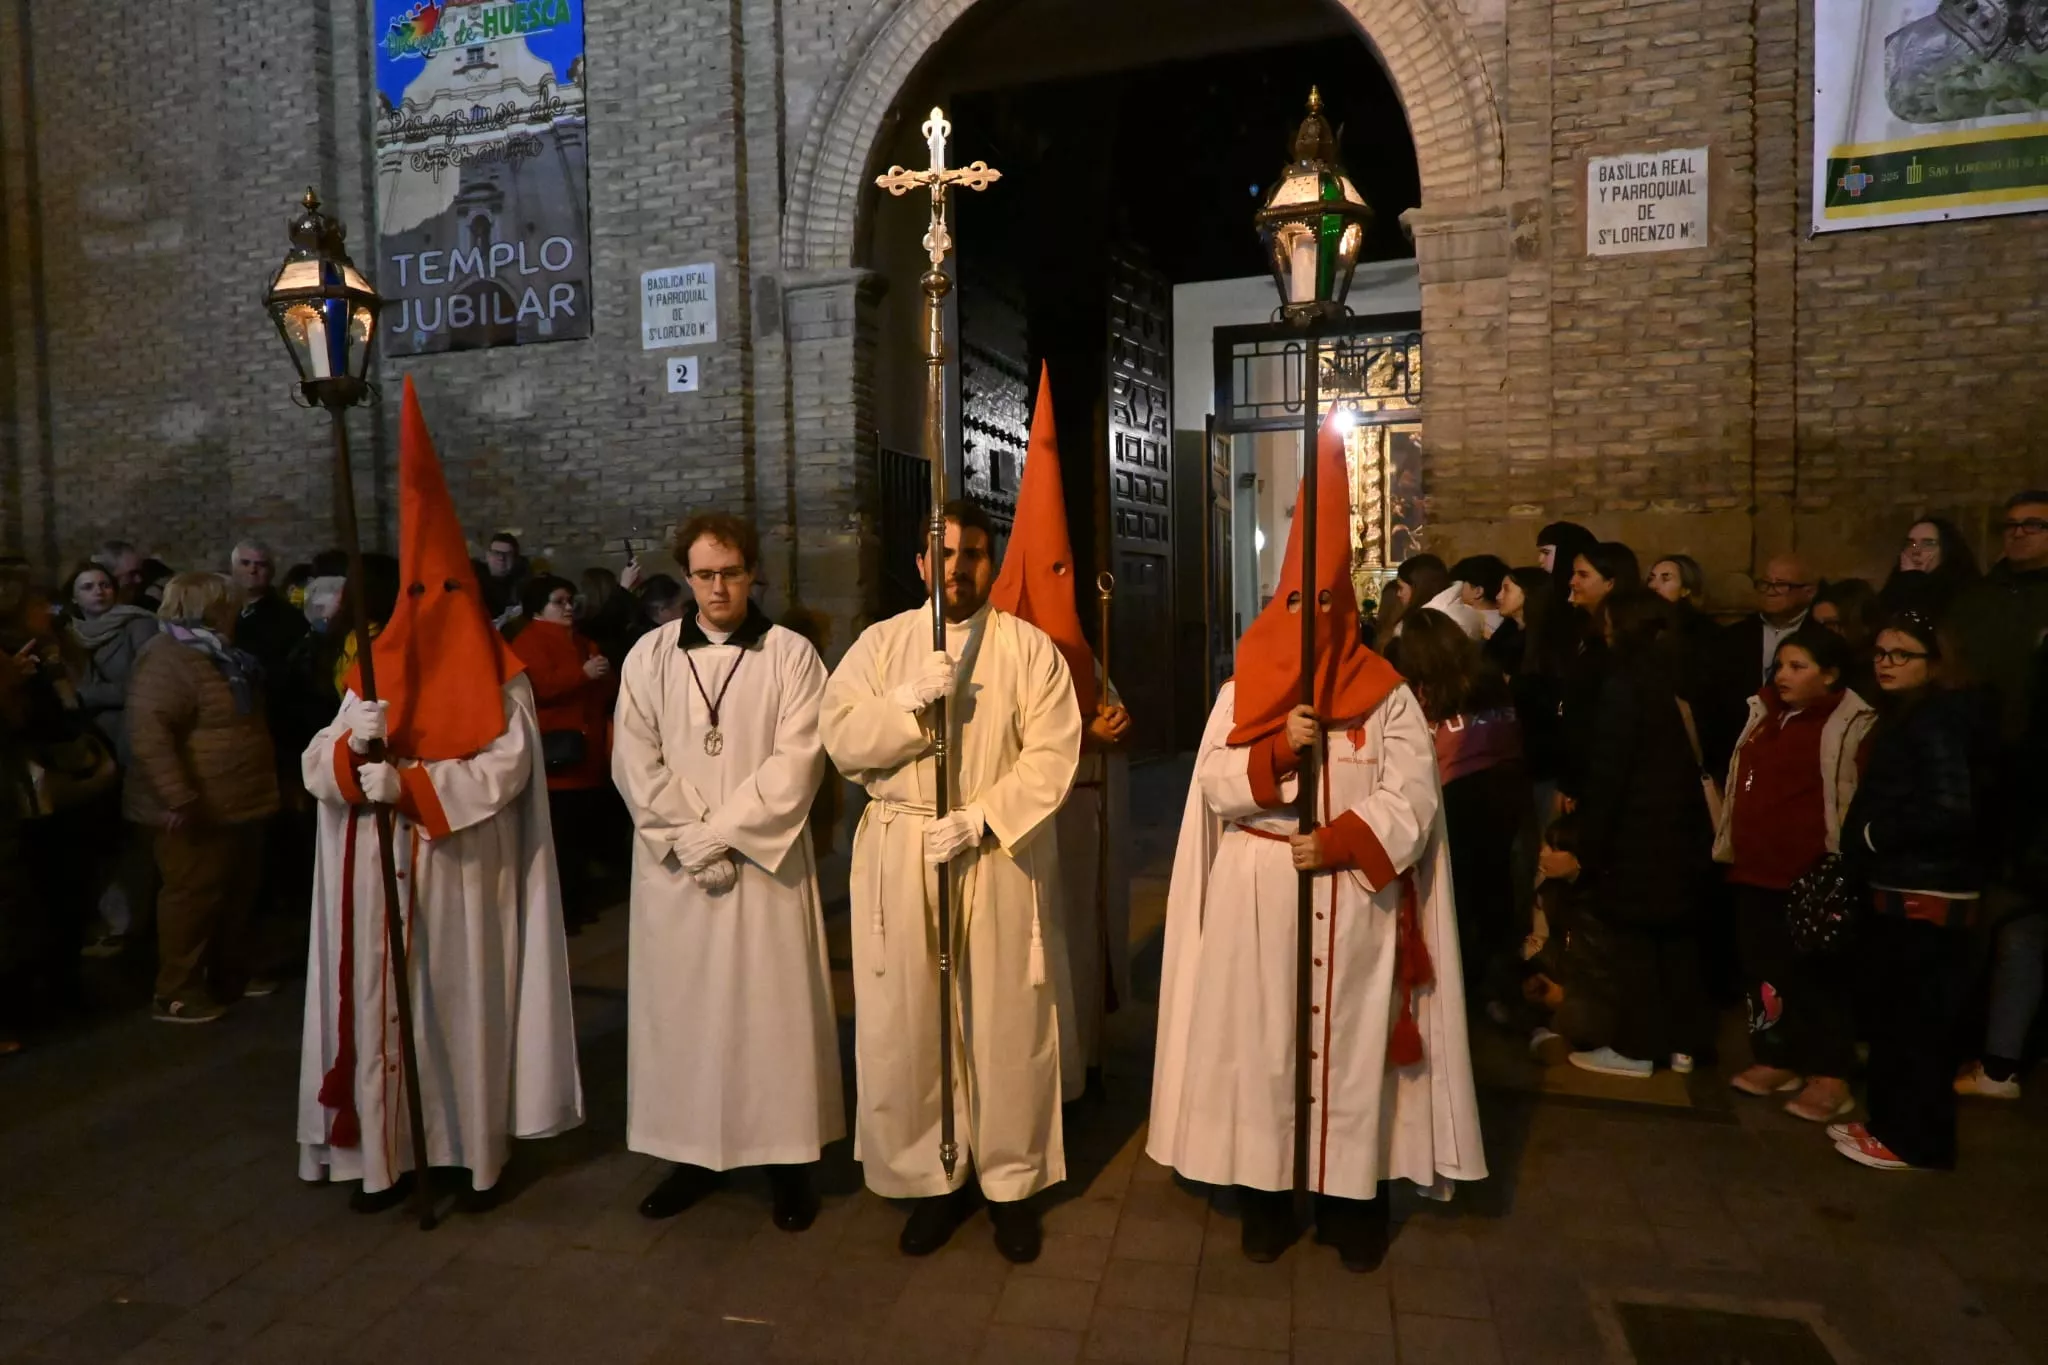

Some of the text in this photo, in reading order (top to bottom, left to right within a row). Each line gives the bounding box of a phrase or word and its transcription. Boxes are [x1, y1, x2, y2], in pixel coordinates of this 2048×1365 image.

[483, 0, 571, 38] HUESCA
[529, 83, 566, 121] de
[1662, 157, 1696, 176] REAL
[1599, 179, 1696, 203] Y PARROQUIAL
[1637, 204, 1656, 221] DE
[1612, 223, 1675, 244] LORENZO
[392, 236, 573, 287] TEMPLO
[686, 271, 709, 287] REAL
[392, 282, 576, 333] JUBILAR
[648, 289, 709, 308] Y PARROQUIAL
[672, 308, 684, 321] DE
[657, 323, 697, 340] LORENZO
[676, 364, 688, 383] 2
